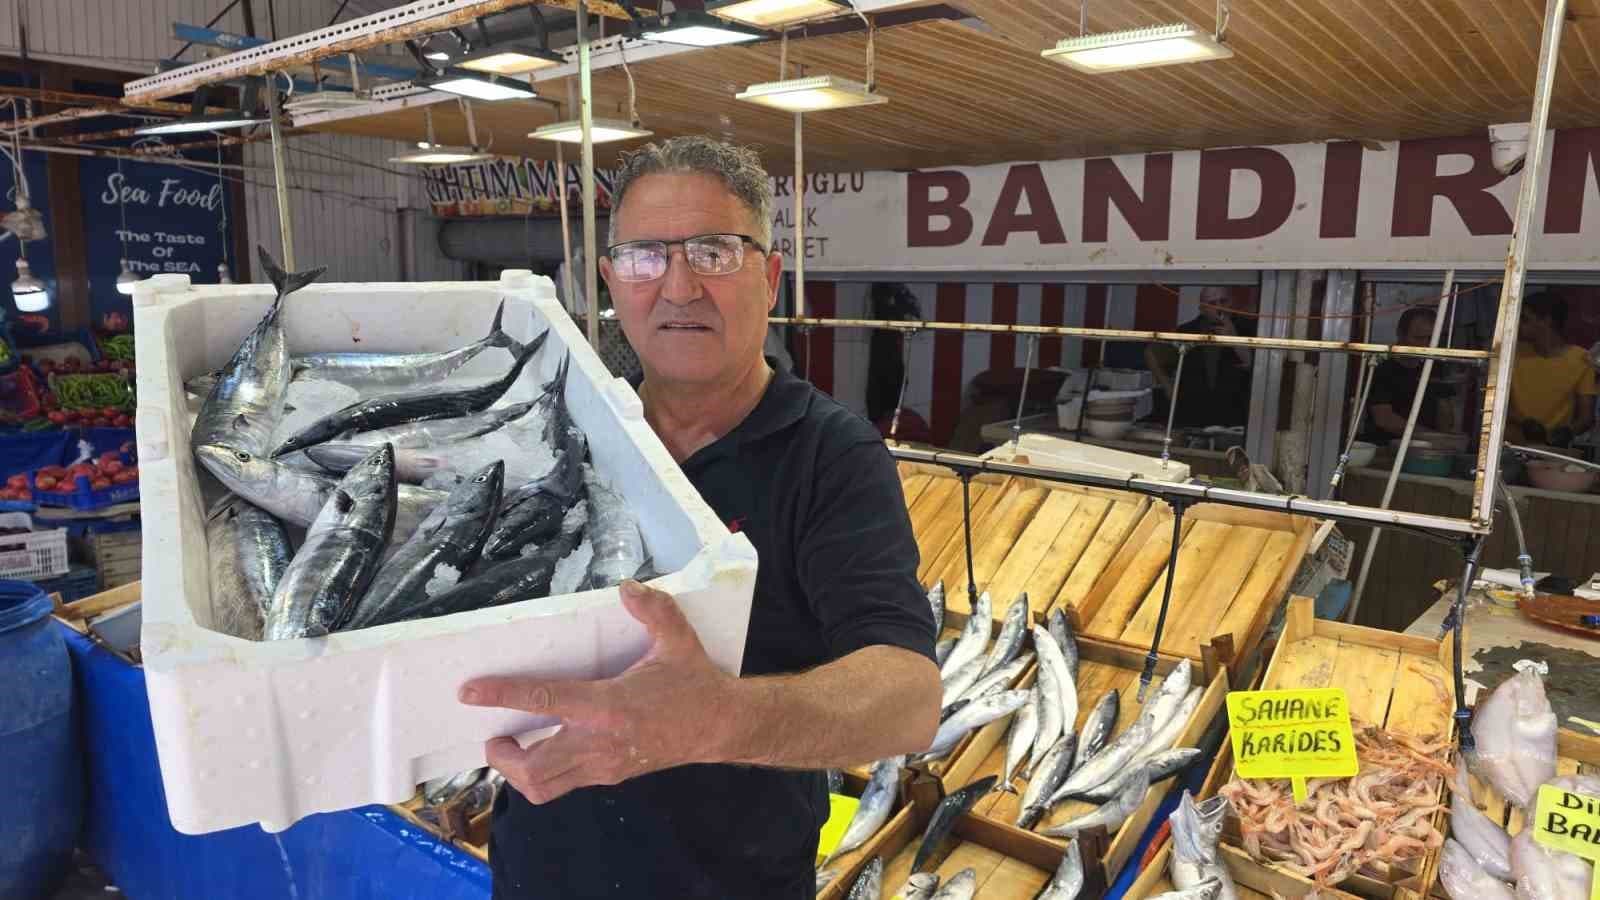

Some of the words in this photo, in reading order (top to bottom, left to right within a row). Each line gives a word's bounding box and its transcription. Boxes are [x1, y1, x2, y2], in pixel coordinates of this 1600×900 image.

[102, 172, 151, 204] Sea
[158, 178, 220, 211] Food
[773, 207, 818, 228] ALK
[115, 230, 150, 242] The
[154, 231, 206, 245] Taste
[152, 246, 174, 258] Of
[127, 260, 159, 272] The
[163, 261, 200, 272] SEA
[1557, 792, 1600, 816] Dİ
